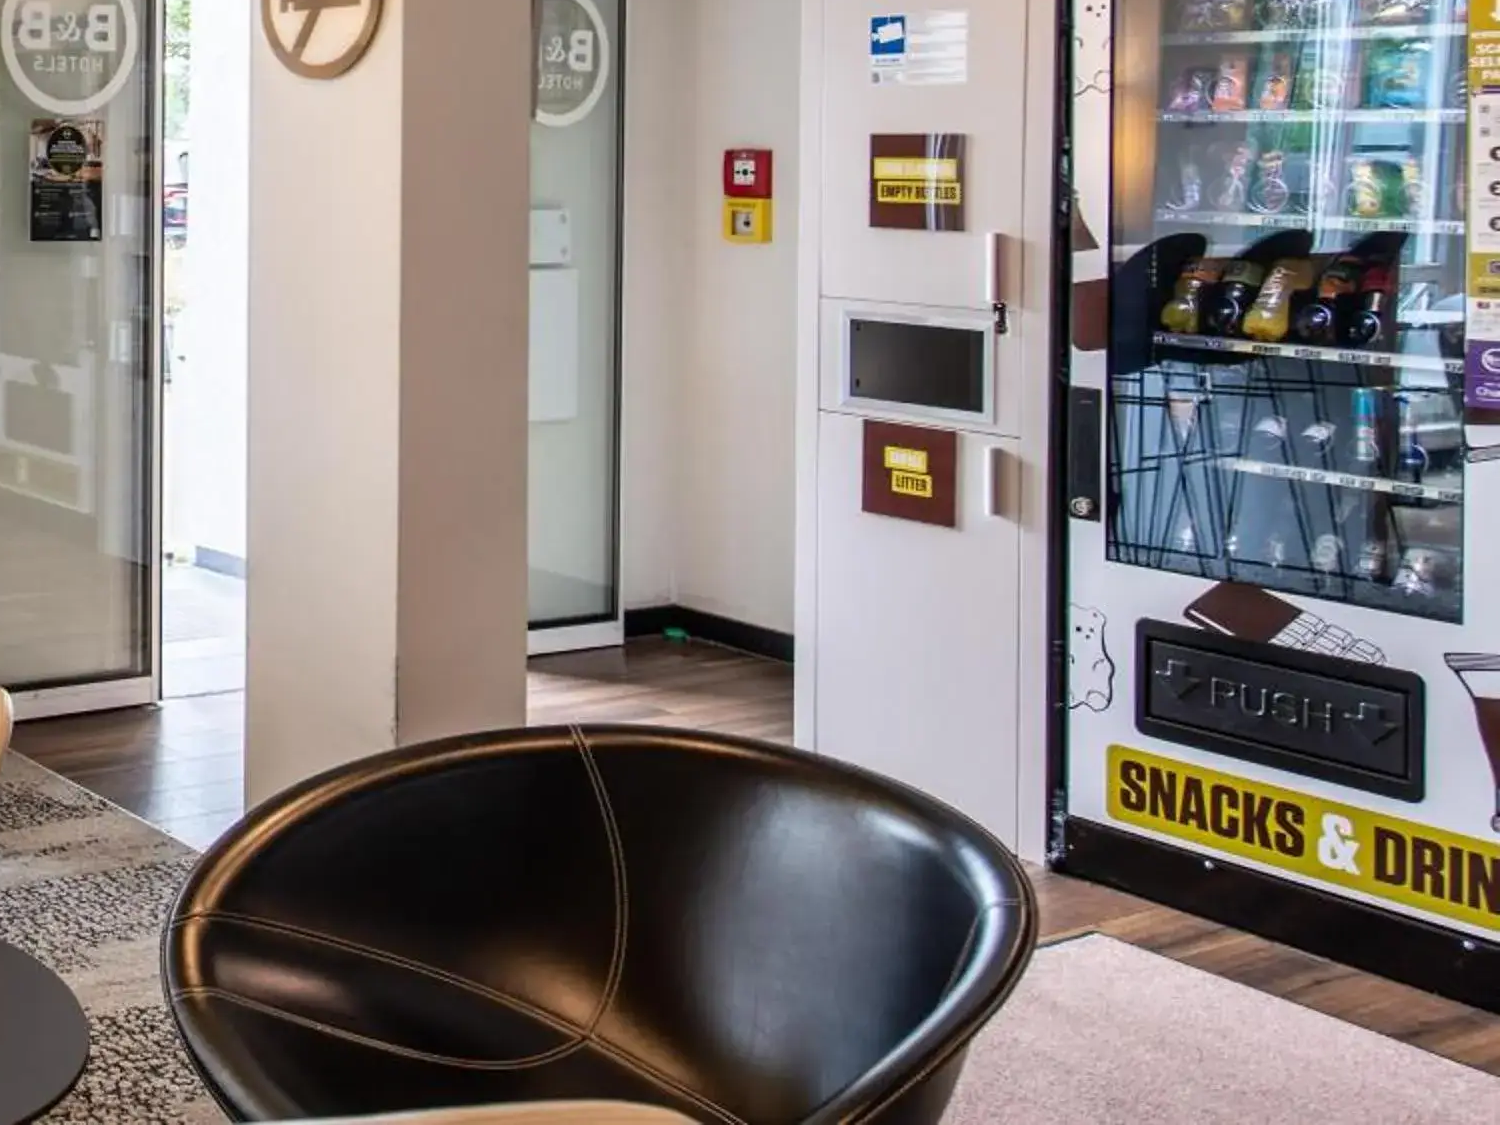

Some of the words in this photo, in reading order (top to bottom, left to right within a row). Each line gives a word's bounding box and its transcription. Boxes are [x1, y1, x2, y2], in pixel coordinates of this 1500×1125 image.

[882, 184, 912, 199] EMPTY
[896, 475, 928, 492] LITTER
[1209, 676, 1333, 736] PUSH
[1119, 759, 1306, 859] SNACKS
[1316, 811, 1361, 876] &
[1373, 826, 1500, 916] DRIN
